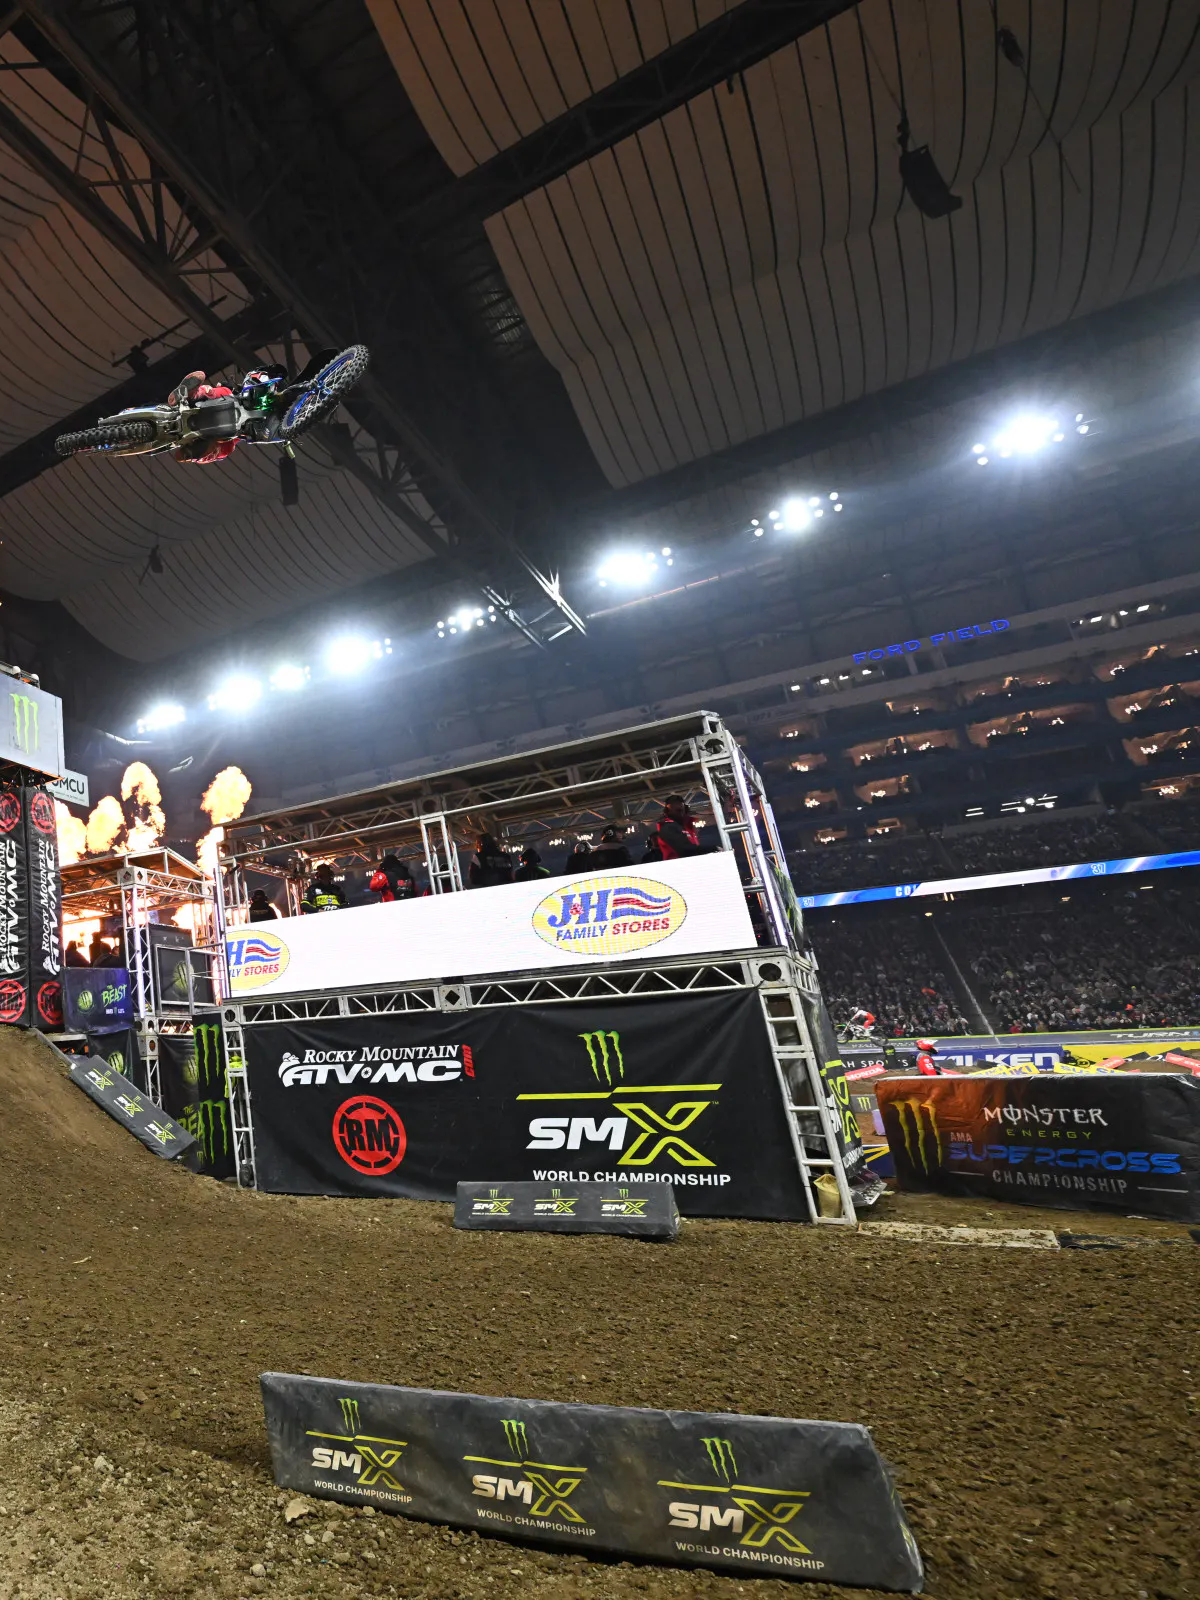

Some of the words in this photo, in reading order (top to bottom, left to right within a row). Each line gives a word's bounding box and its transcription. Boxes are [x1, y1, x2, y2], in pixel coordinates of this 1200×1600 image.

[852, 639, 922, 664] FORD
[929, 618, 1011, 646] FIELD
[1091, 863, 1106, 875] 37
[547, 888, 611, 928] J&H
[556, 924, 608, 941] FAMILY
[612, 917, 670, 935] STORES
[244, 963, 280, 977] STORES
[101, 983, 128, 1008] BEAST
[302, 1049, 357, 1064] ROCKY
[359, 1044, 460, 1062] MOUNTAIN
[847, 1066, 884, 1080] HONDA
[183, 1104, 194, 1115] THE
[982, 1104, 1109, 1126] MONSTER
[525, 1101, 717, 1167] SMX
[950, 1132, 973, 1142] AMA
[1006, 1128, 1093, 1140] ENERGY
[949, 1144, 1182, 1175] SUPERCROSS
[533, 1169, 590, 1183] WORLD
[594, 1171, 731, 1186] CHAMPIONSHIP
[992, 1170, 1128, 1194] CHAMPIONSHIP
[472, 1201, 511, 1213] SMX
[534, 1201, 573, 1213] SMX
[601, 1201, 646, 1215] SMX
[311, 1445, 405, 1491] SMX
[314, 1480, 344, 1491] WORLD
[345, 1486, 413, 1504] CHAMPIONSHIP
[472, 1471, 587, 1523] SMX
[477, 1508, 512, 1522] WORLD
[514, 1516, 596, 1537] CHAMPIONSHIP
[668, 1497, 813, 1554] SMX
[676, 1541, 720, 1555] WORLD
[722, 1547, 825, 1571] CHAMPIONSHIP
